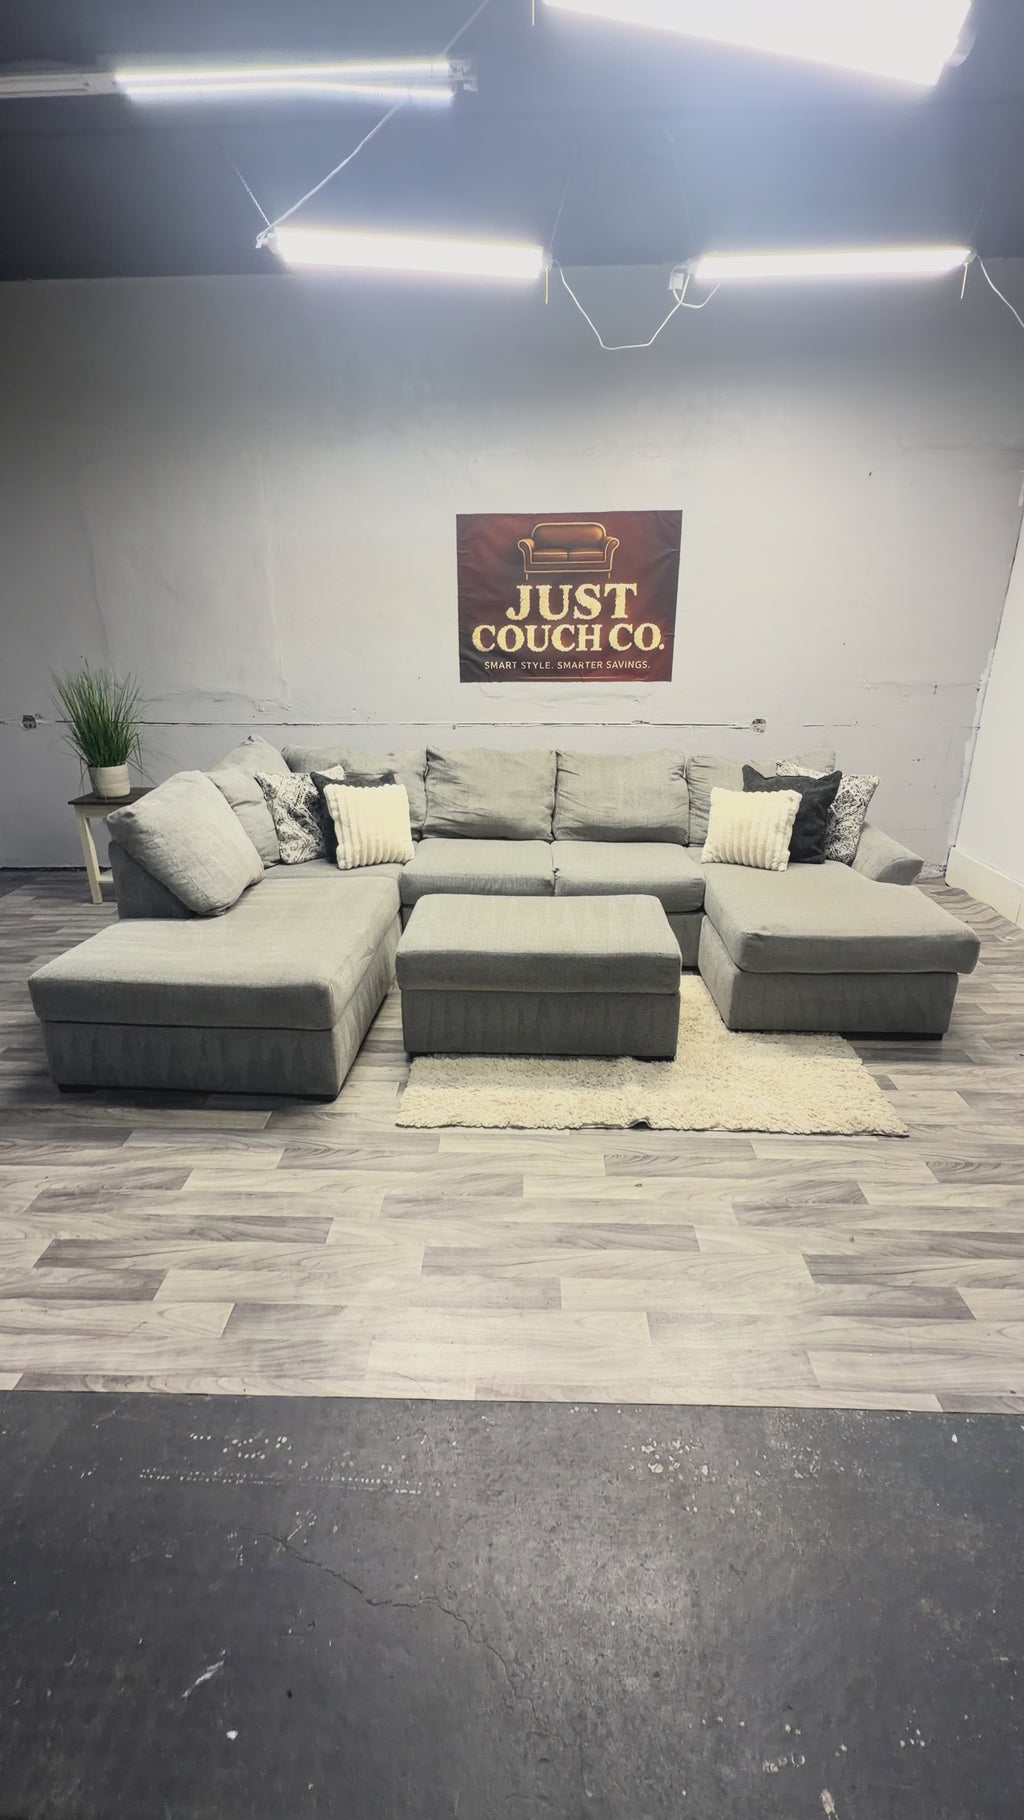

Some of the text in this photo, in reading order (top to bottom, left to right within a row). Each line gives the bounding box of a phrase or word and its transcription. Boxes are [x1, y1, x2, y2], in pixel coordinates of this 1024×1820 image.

[505, 582, 638, 621] JUST
[471, 621, 665, 653] COUCH CO.
[484, 660, 650, 670] SMART STYLE. SMARTER SAVINGS.
